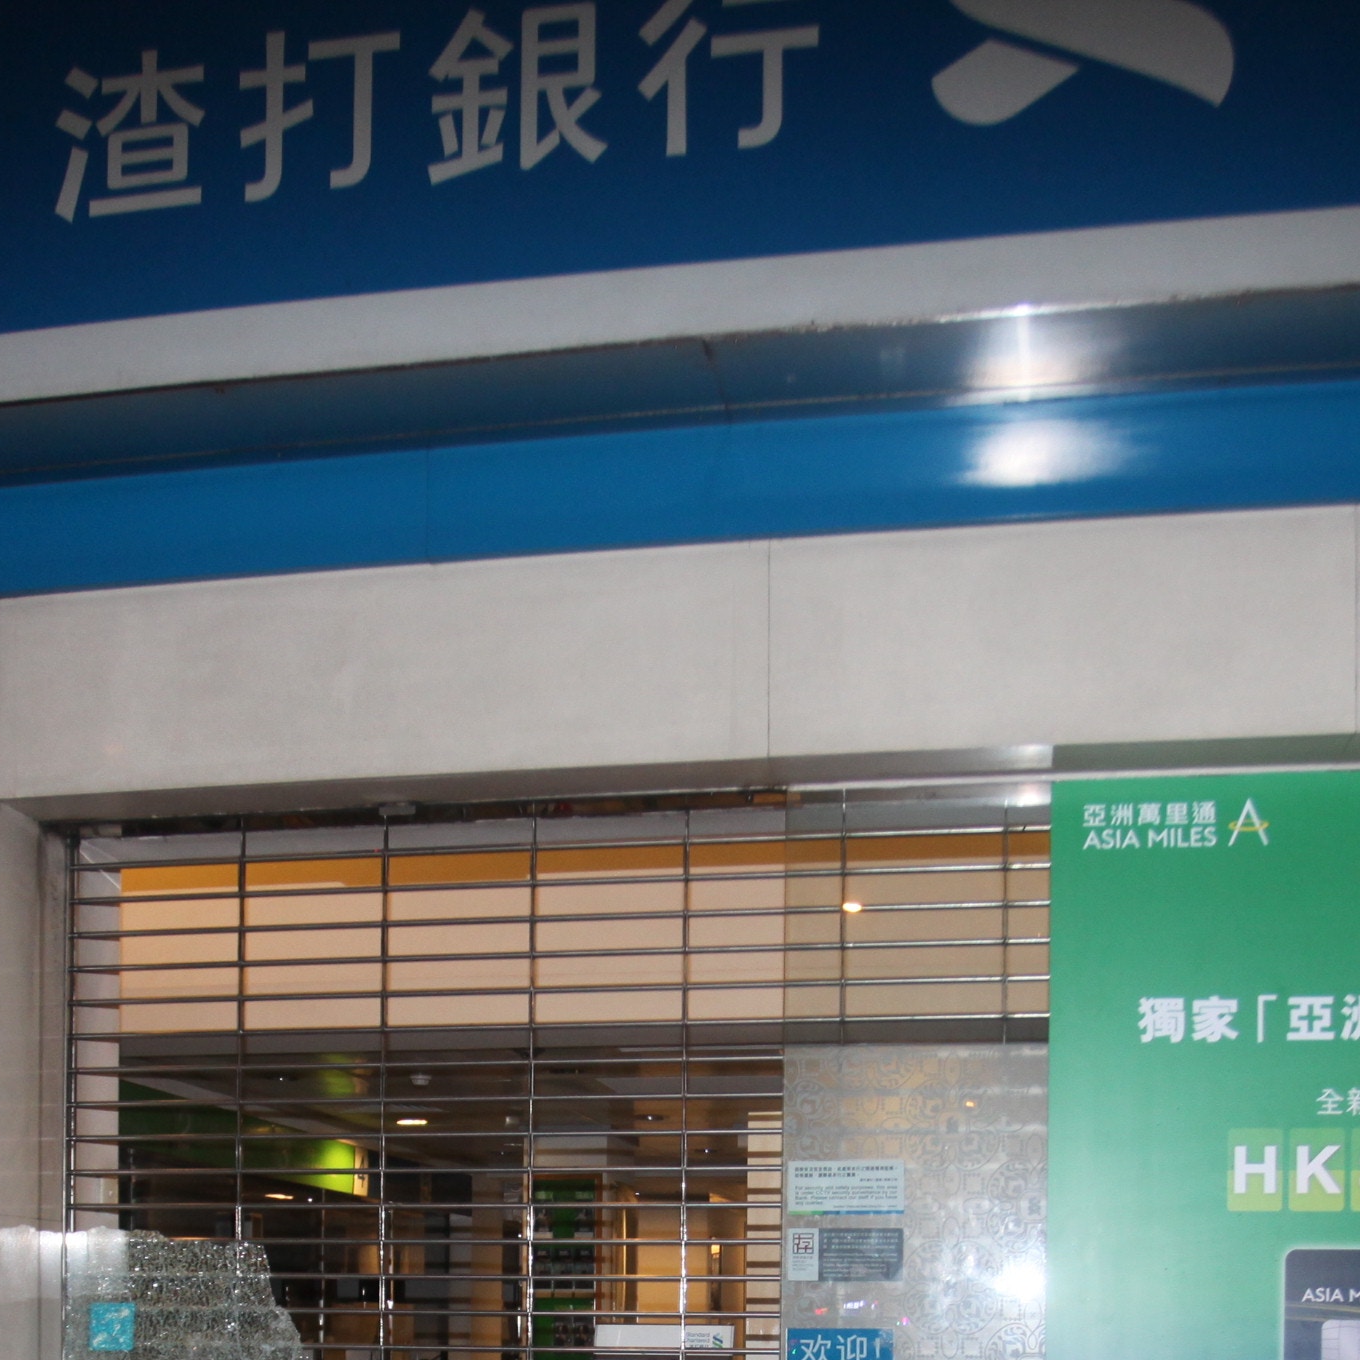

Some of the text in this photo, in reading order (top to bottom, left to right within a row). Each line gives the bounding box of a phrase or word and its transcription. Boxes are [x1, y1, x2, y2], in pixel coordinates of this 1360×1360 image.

[54, 1, 819, 223] 渣打銀行
[1083, 800, 1217, 827] 亞洲萬里通
[1083, 825, 1217, 850] ASIA MILES
[1301, 1287, 1347, 1303] ASIA
